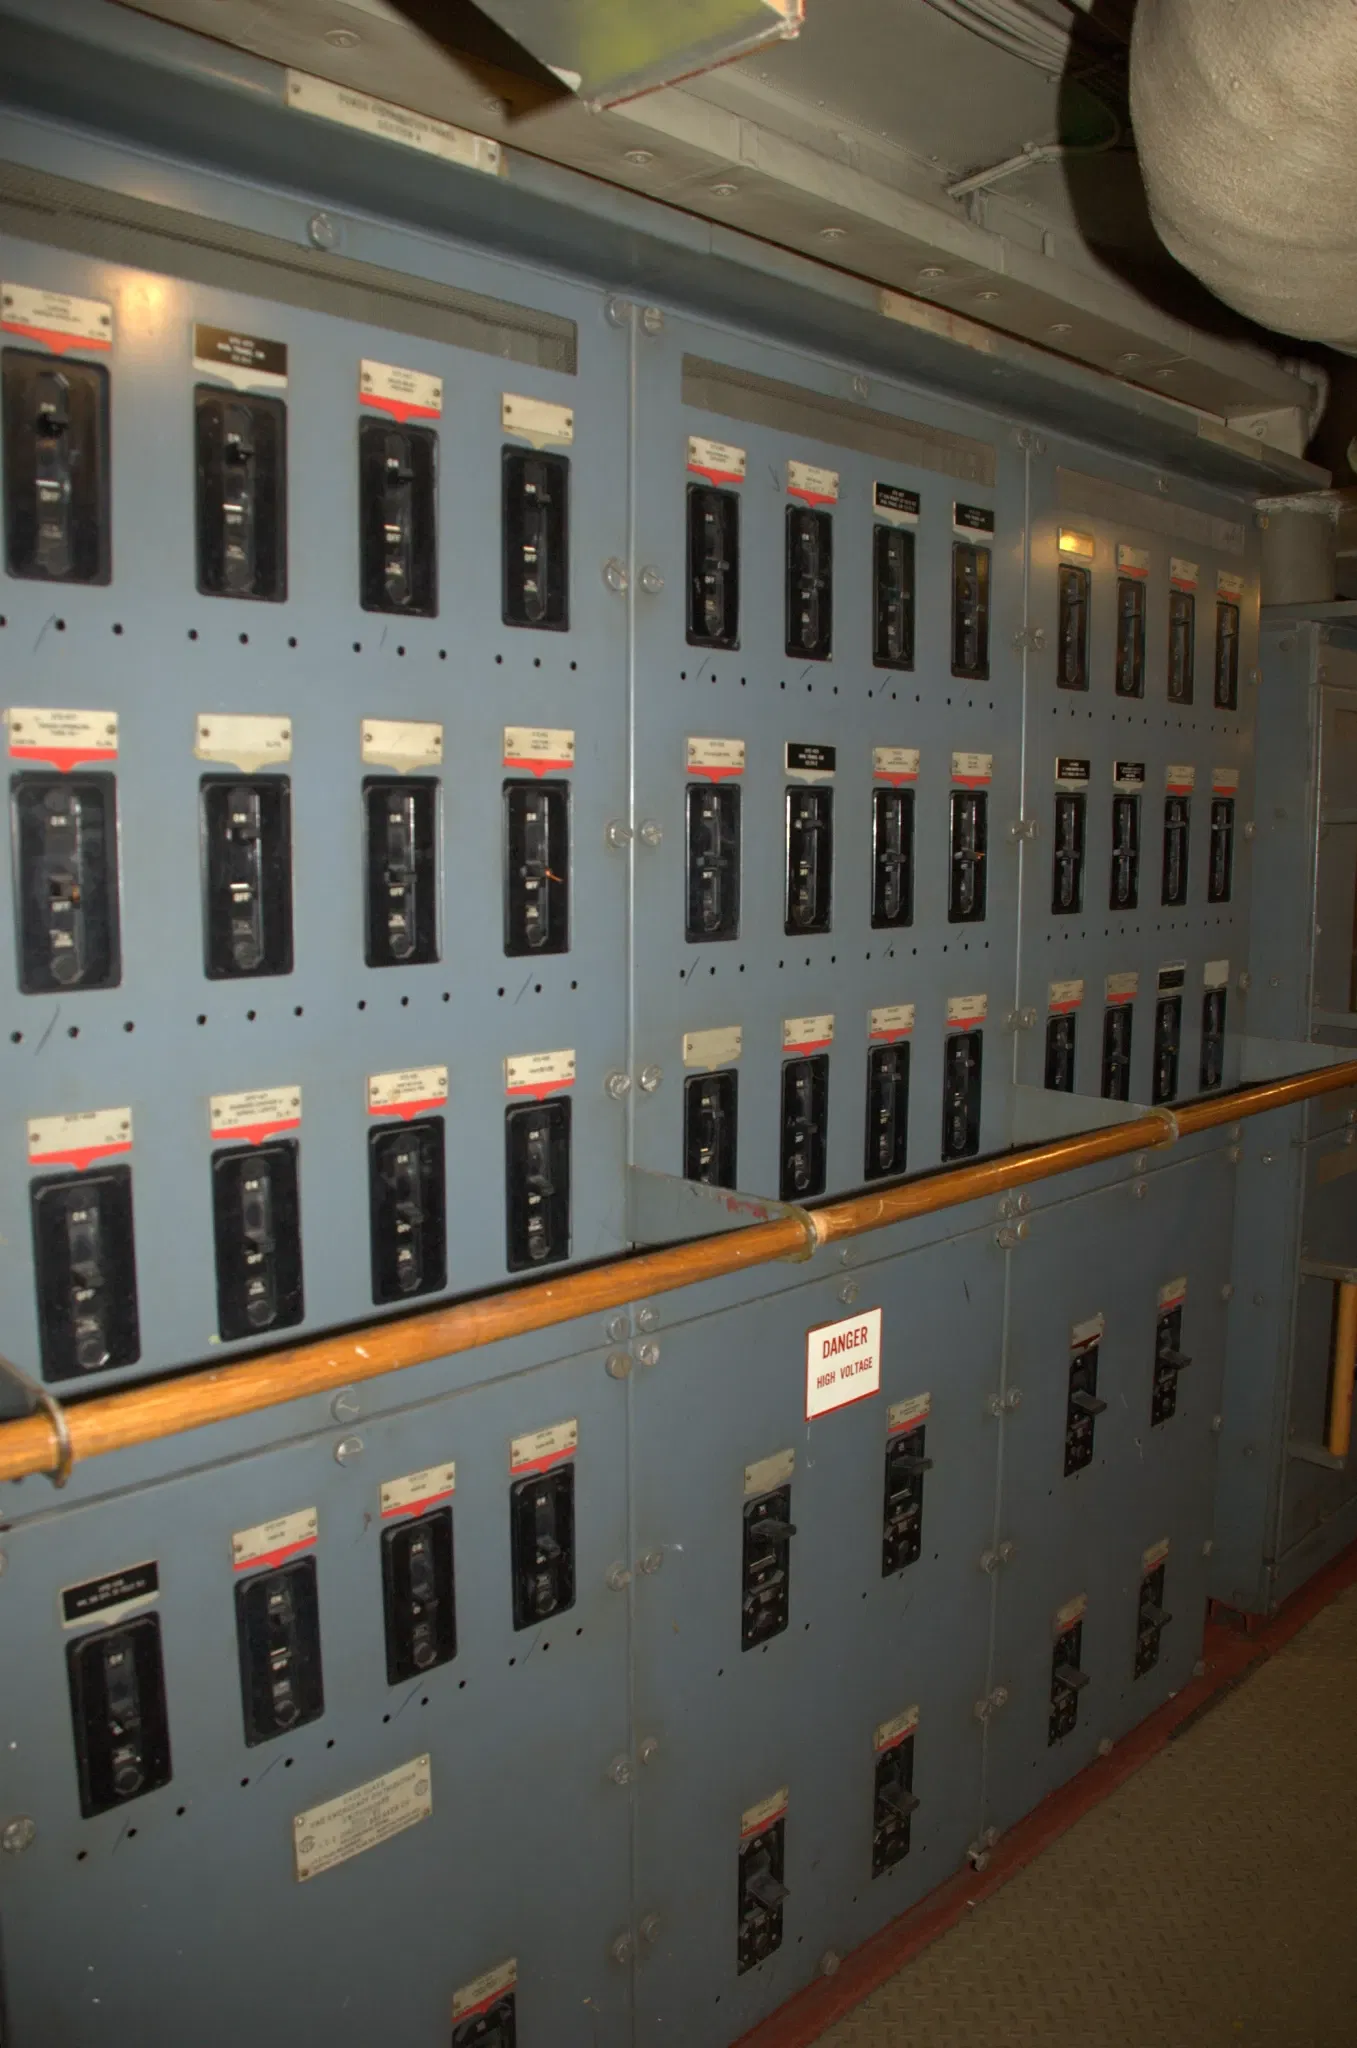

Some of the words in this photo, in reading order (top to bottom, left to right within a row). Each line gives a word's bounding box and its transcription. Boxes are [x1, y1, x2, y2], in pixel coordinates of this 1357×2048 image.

[822, 1326, 868, 1359] DANGER
[817, 1371, 836, 1389] HIGH
[840, 1357, 873, 1379] VOLTAGE
